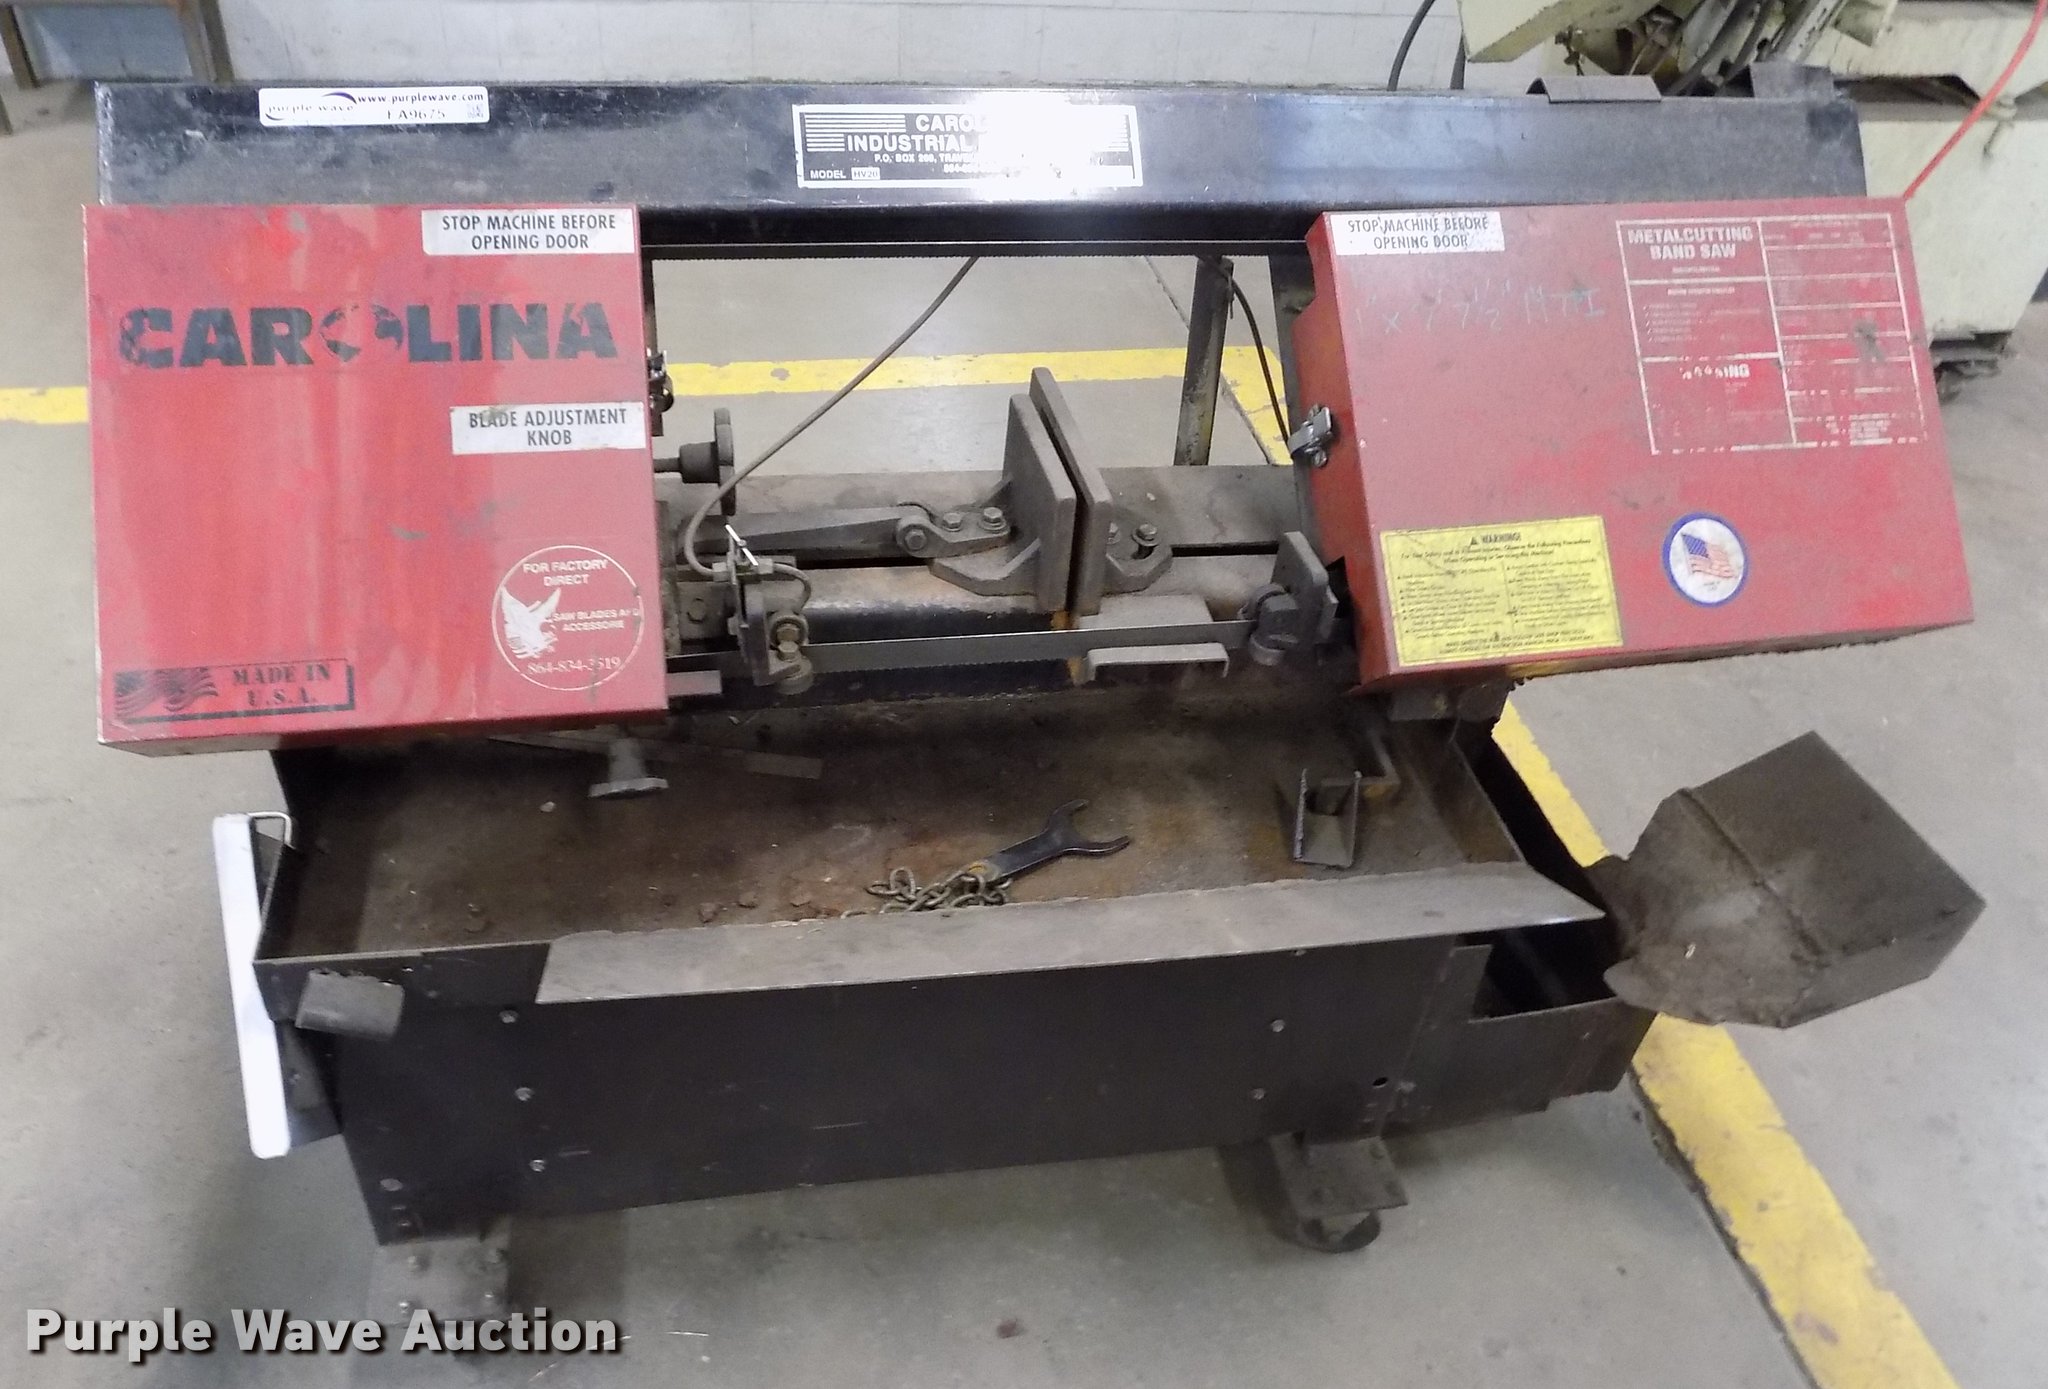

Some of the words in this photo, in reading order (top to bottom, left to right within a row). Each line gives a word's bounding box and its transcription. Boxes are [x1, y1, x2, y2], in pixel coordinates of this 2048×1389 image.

[358, 91, 484, 105] www.purplewave.com
[268, 103, 313, 114] purple
[318, 104, 354, 113] wave
[847, 134, 973, 152] INDUSTRIAL
[810, 169, 847, 179] MODEL
[442, 215, 481, 231] STOP
[487, 214, 556, 230] MACHINE
[557, 214, 616, 229] BEFORE
[1347, 218, 1379, 234] STOP
[1382, 216, 1440, 233] MACHINE
[1443, 215, 1488, 231] BEFORE
[471, 234, 539, 250] OPENING
[546, 233, 589, 249] DOOR
[1372, 235, 1429, 249] OPENING
[1433, 233, 1468, 248] DOOR
[1628, 226, 1754, 245] METALCUTTING
[1650, 244, 1696, 260] BAND
[1700, 243, 1736, 259] SAW
[118, 302, 618, 368] CAROLINA
[469, 411, 517, 428] BLADE
[524, 408, 627, 427] ADJUSTMENT
[527, 430, 572, 446] KNOB
[523, 563, 549, 573] FOR
[552, 559, 608, 572] FACTORY
[543, 574, 590, 586] DIRECT
[578, 610, 618, 621] BLADES
[232, 665, 296, 686] MADE
[306, 662, 331, 682] IN
